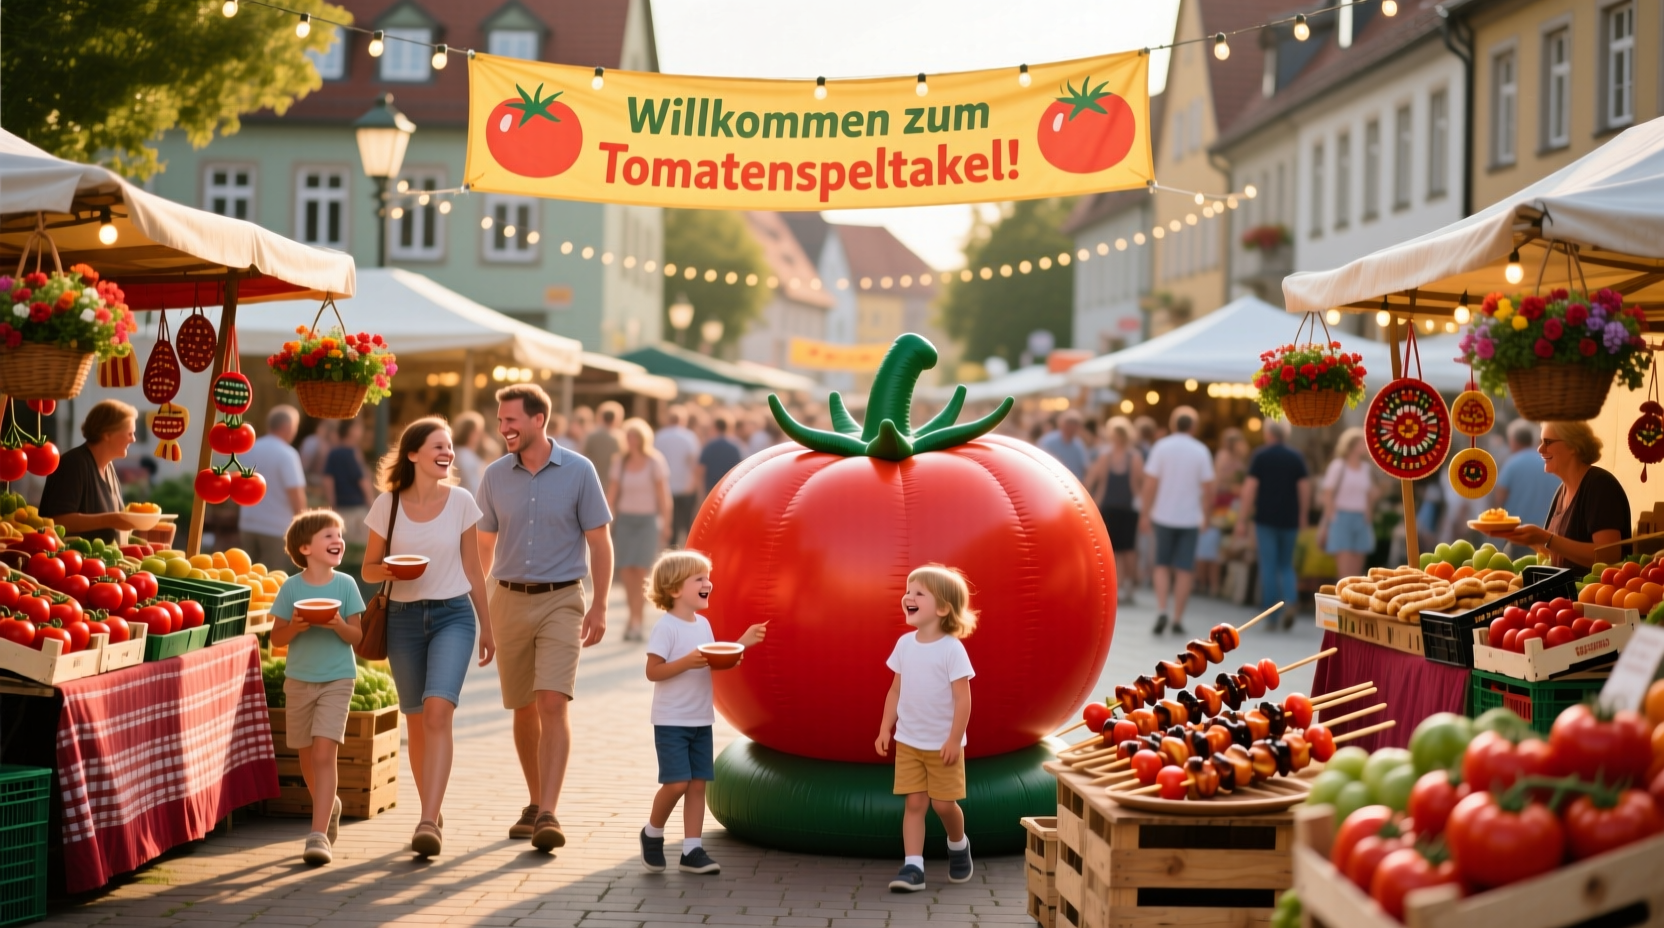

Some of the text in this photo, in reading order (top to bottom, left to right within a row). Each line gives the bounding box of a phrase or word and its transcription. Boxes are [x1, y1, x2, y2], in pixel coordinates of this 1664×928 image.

[628, 97, 990, 138] Willkommen zum
[599, 138, 1019, 203] Tomatenspeltakel!
